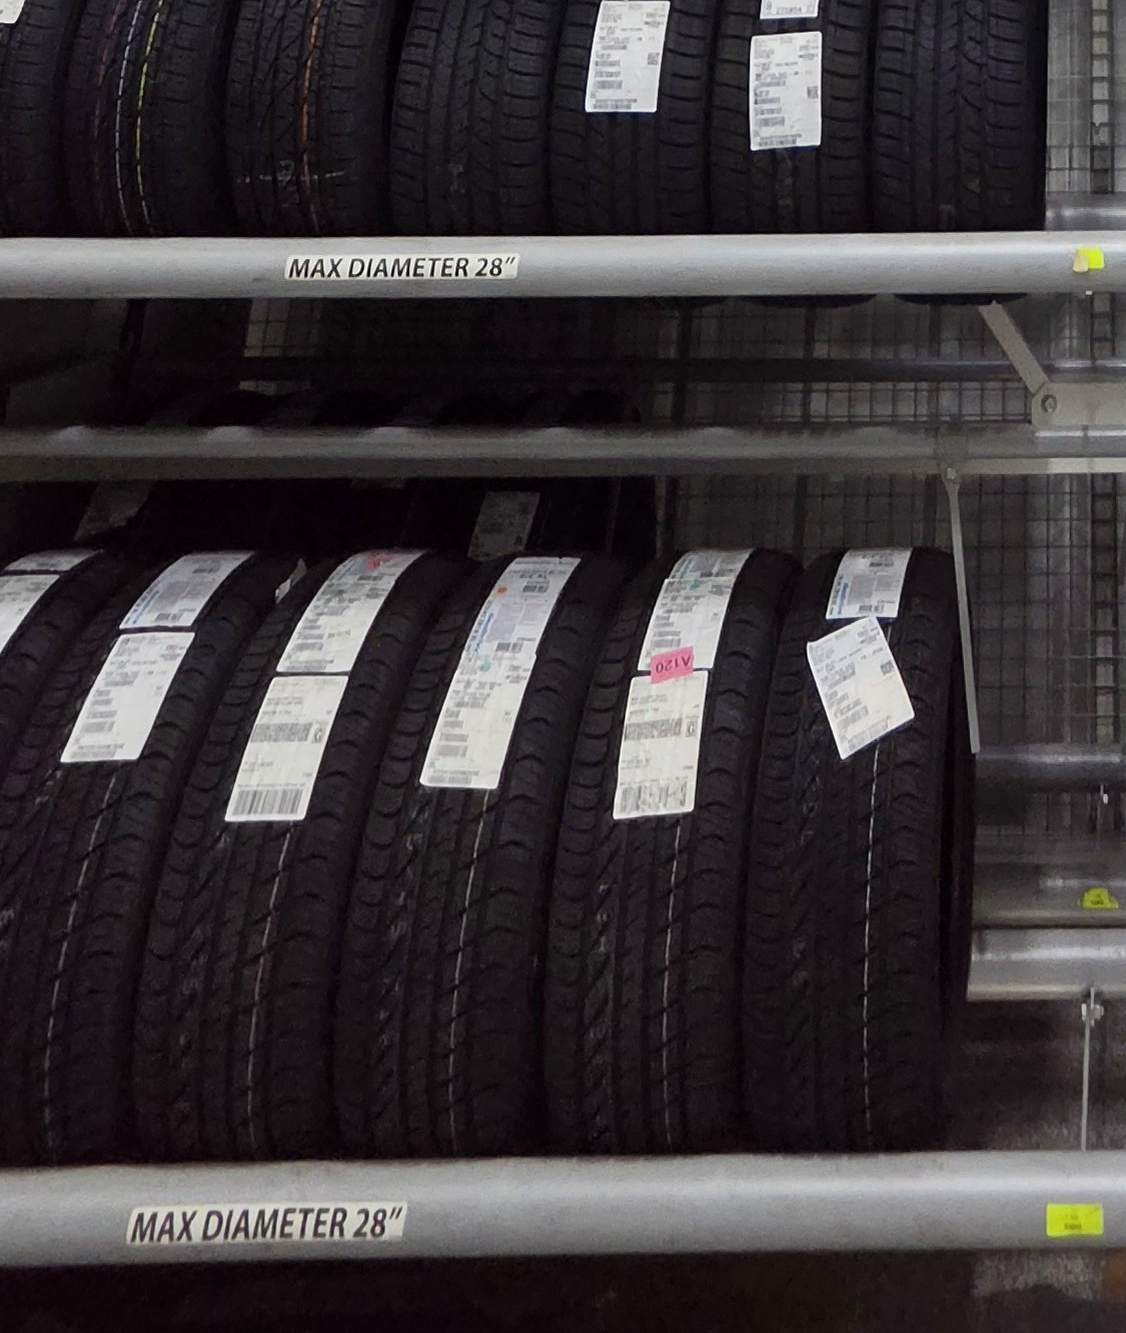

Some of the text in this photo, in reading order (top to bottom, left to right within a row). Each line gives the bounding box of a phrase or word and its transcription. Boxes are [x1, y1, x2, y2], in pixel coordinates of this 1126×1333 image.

[288, 256, 517, 278] MAX DIAMETER 28"
[655, 654, 692, 674] A120
[130, 1206, 403, 1243] MAX DIAMETER 28"
